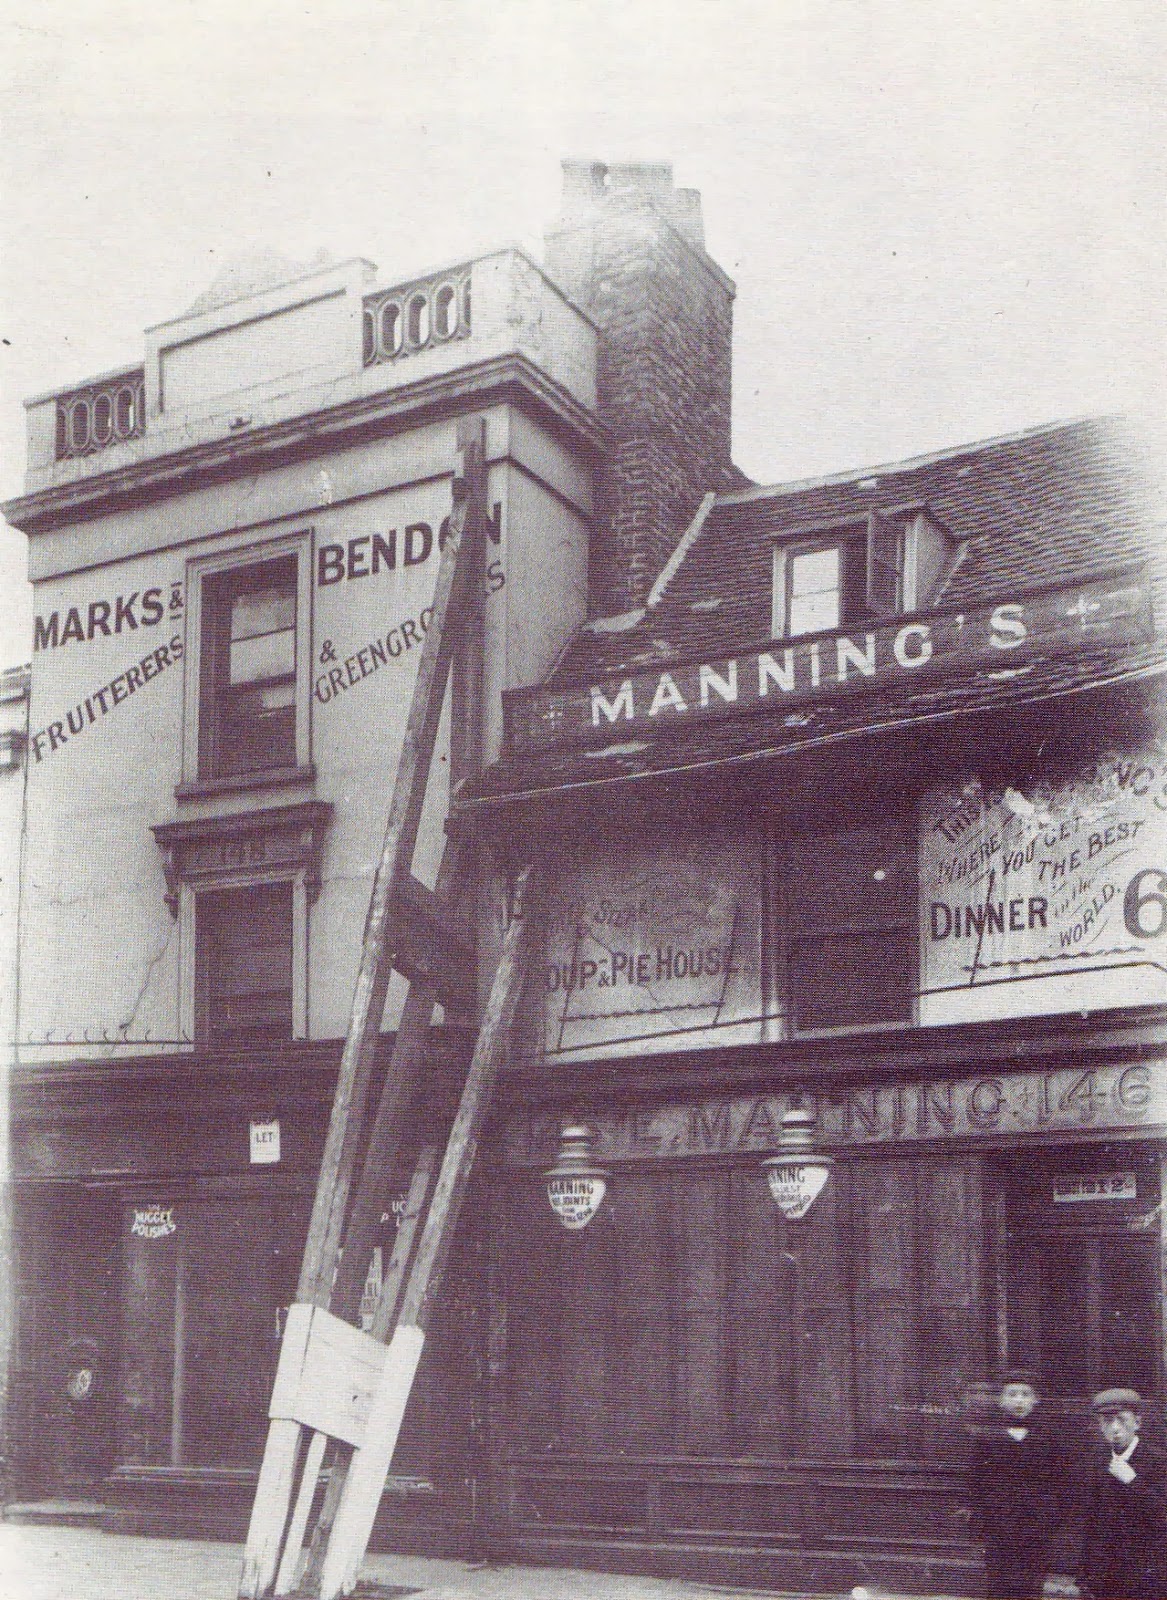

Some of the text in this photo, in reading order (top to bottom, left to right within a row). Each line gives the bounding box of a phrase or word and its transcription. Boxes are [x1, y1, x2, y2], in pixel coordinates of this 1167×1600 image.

[33, 587, 164, 652] MARKS
[319, 638, 337, 664] &
[31, 633, 185, 764] FRUITERERS
[1002, 835, 1038, 876] YOU
[1037, 850, 1081, 882] THE
[1088, 820, 1145, 860] BEST
[930, 896, 1049, 942] DINNER
[1123, 868, 1167, 939] 6
[545, 960, 597, 992] OUP
[611, 951, 651, 987] PIE
[255, 1131, 273, 1143] LET
